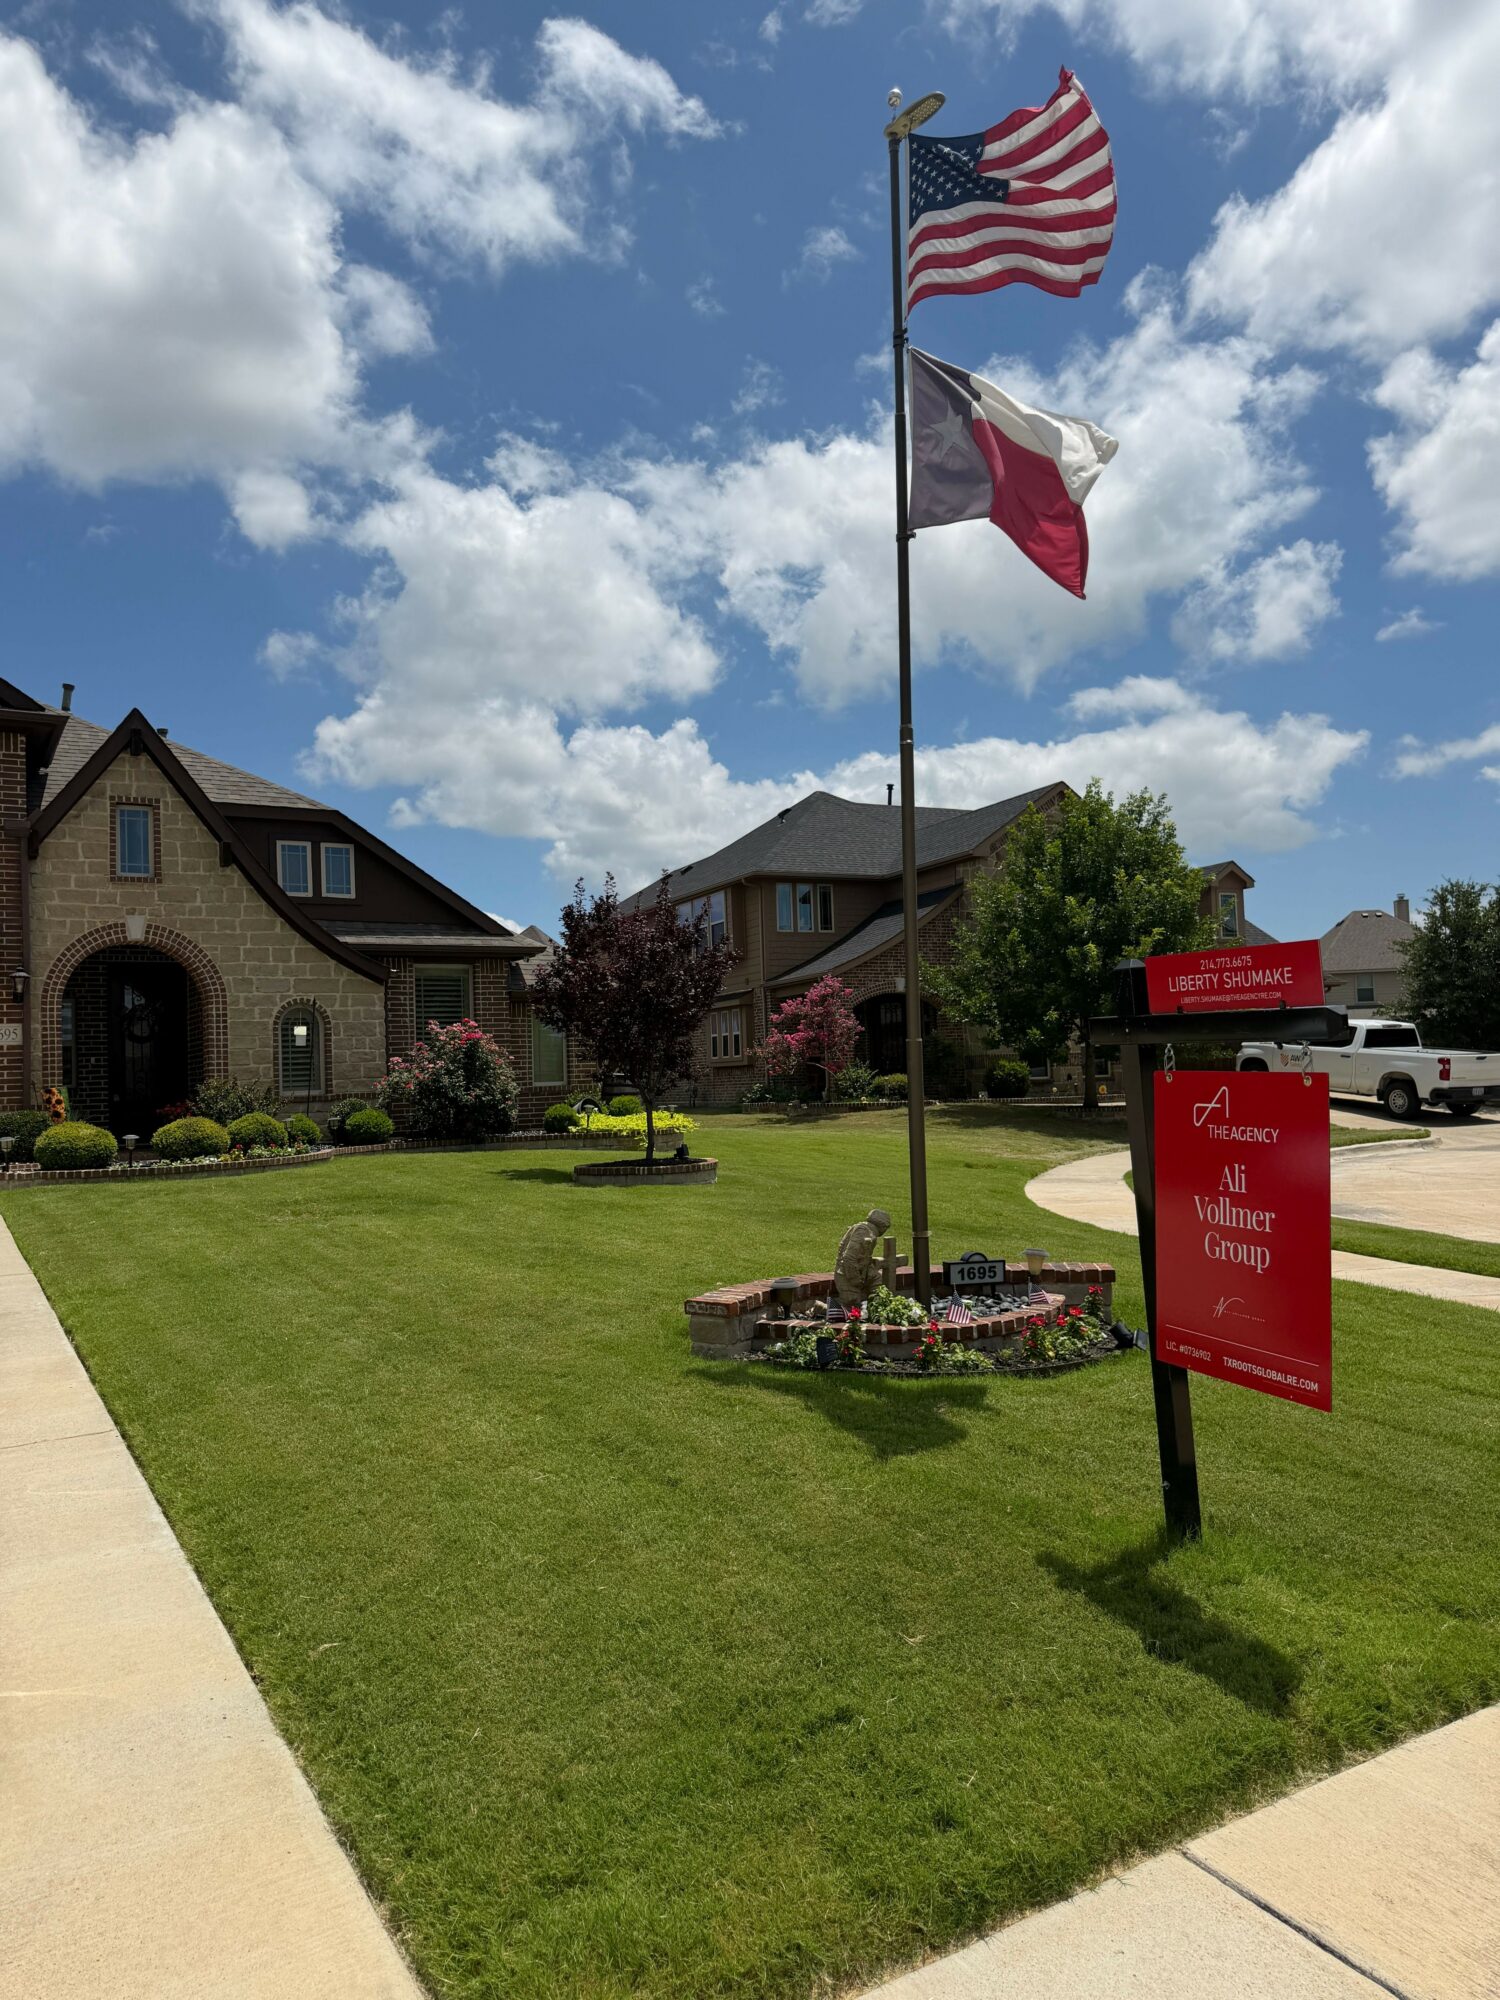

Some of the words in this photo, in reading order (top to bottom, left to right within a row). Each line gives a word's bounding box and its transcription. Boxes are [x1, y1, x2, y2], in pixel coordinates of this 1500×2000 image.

[1200, 955, 1252, 970] 214.773.6675
[1168, 973, 1219, 992] LIBERTY
[1223, 967, 1293, 989] SHUMAKE
[1219, 1163, 1247, 1194] Ali
[1193, 1195, 1276, 1232] Vollmer
[1204, 1231, 1270, 1274] Group
[957, 1266, 996, 1281] 1695
[1166, 1340, 1178, 1352] LIC.
[1223, 1356, 1318, 1392] TXROOTSGLOBALRE.COM
